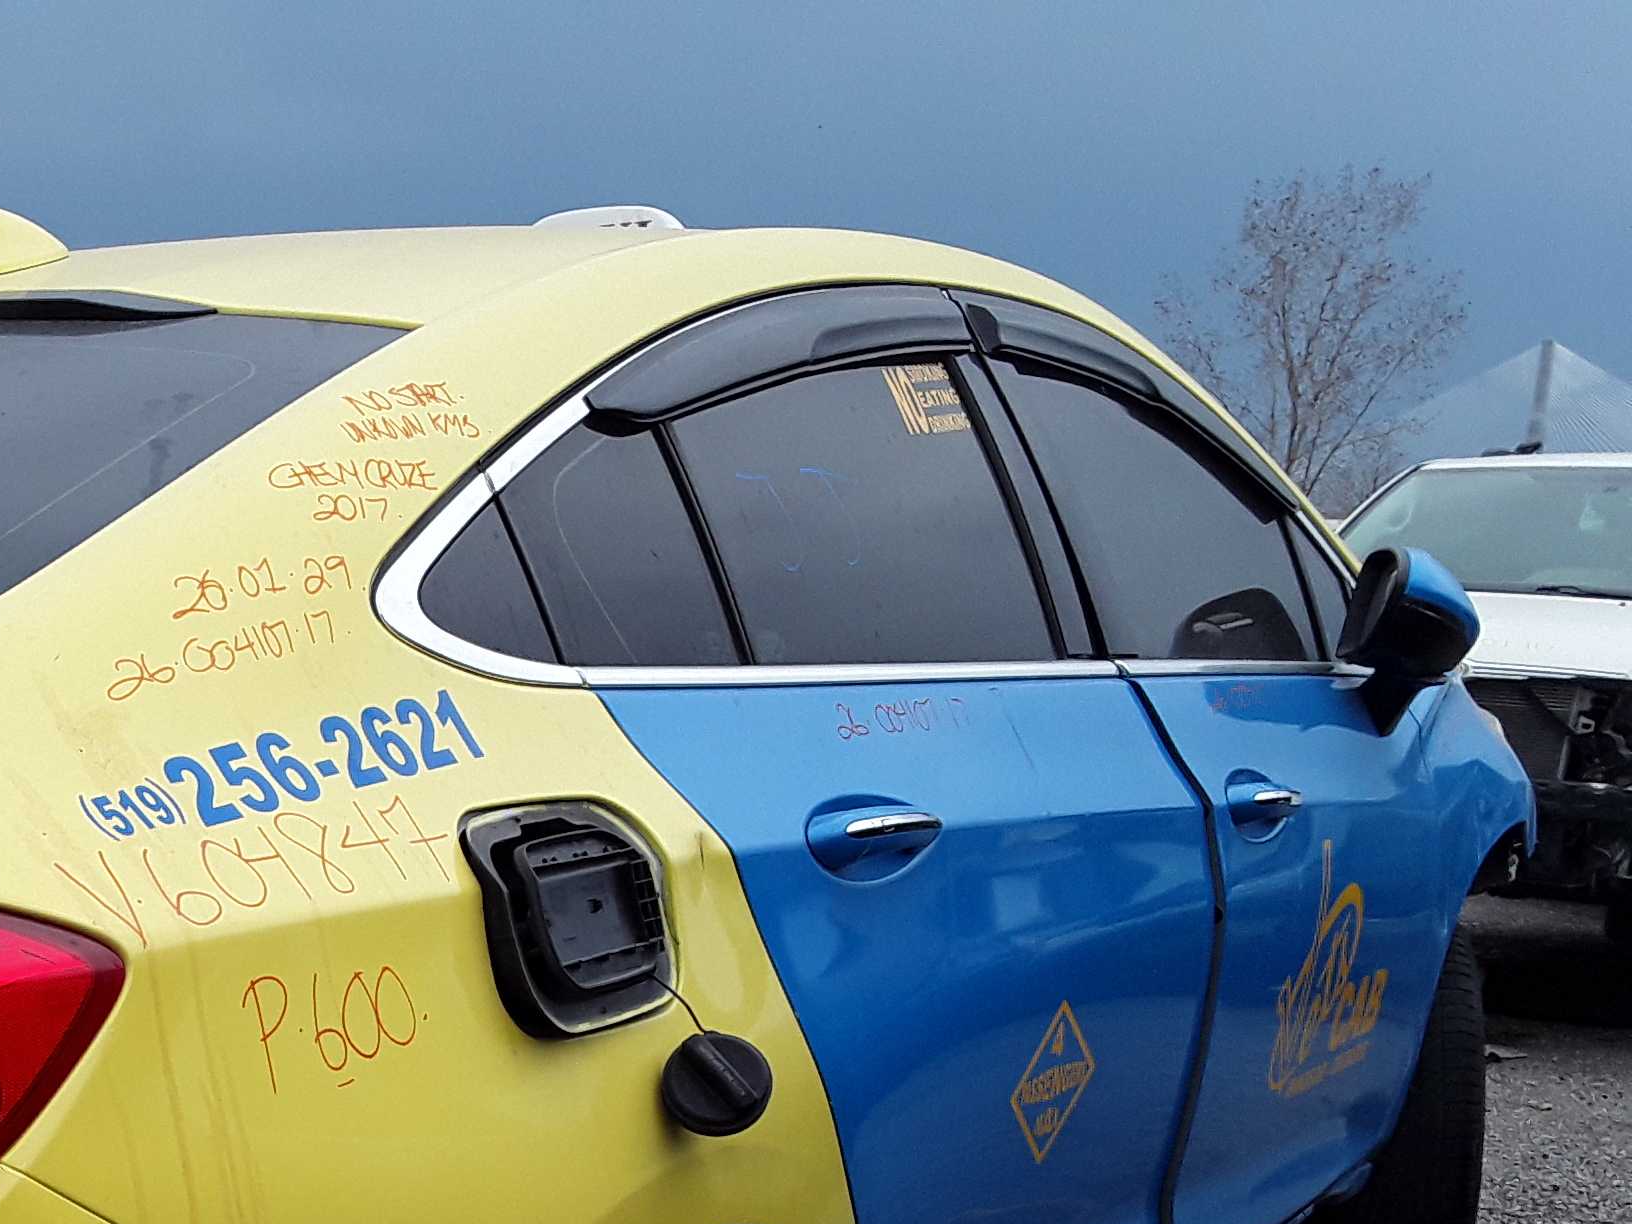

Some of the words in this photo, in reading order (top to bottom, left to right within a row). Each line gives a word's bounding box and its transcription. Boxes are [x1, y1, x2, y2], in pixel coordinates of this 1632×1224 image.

[342, 390, 392, 416] NO
[917, 388, 960, 408] EATING
[365, 458, 439, 491] CRUZE
[79, 778, 186, 841] (519)
[164, 690, 485, 827] 256-2621
